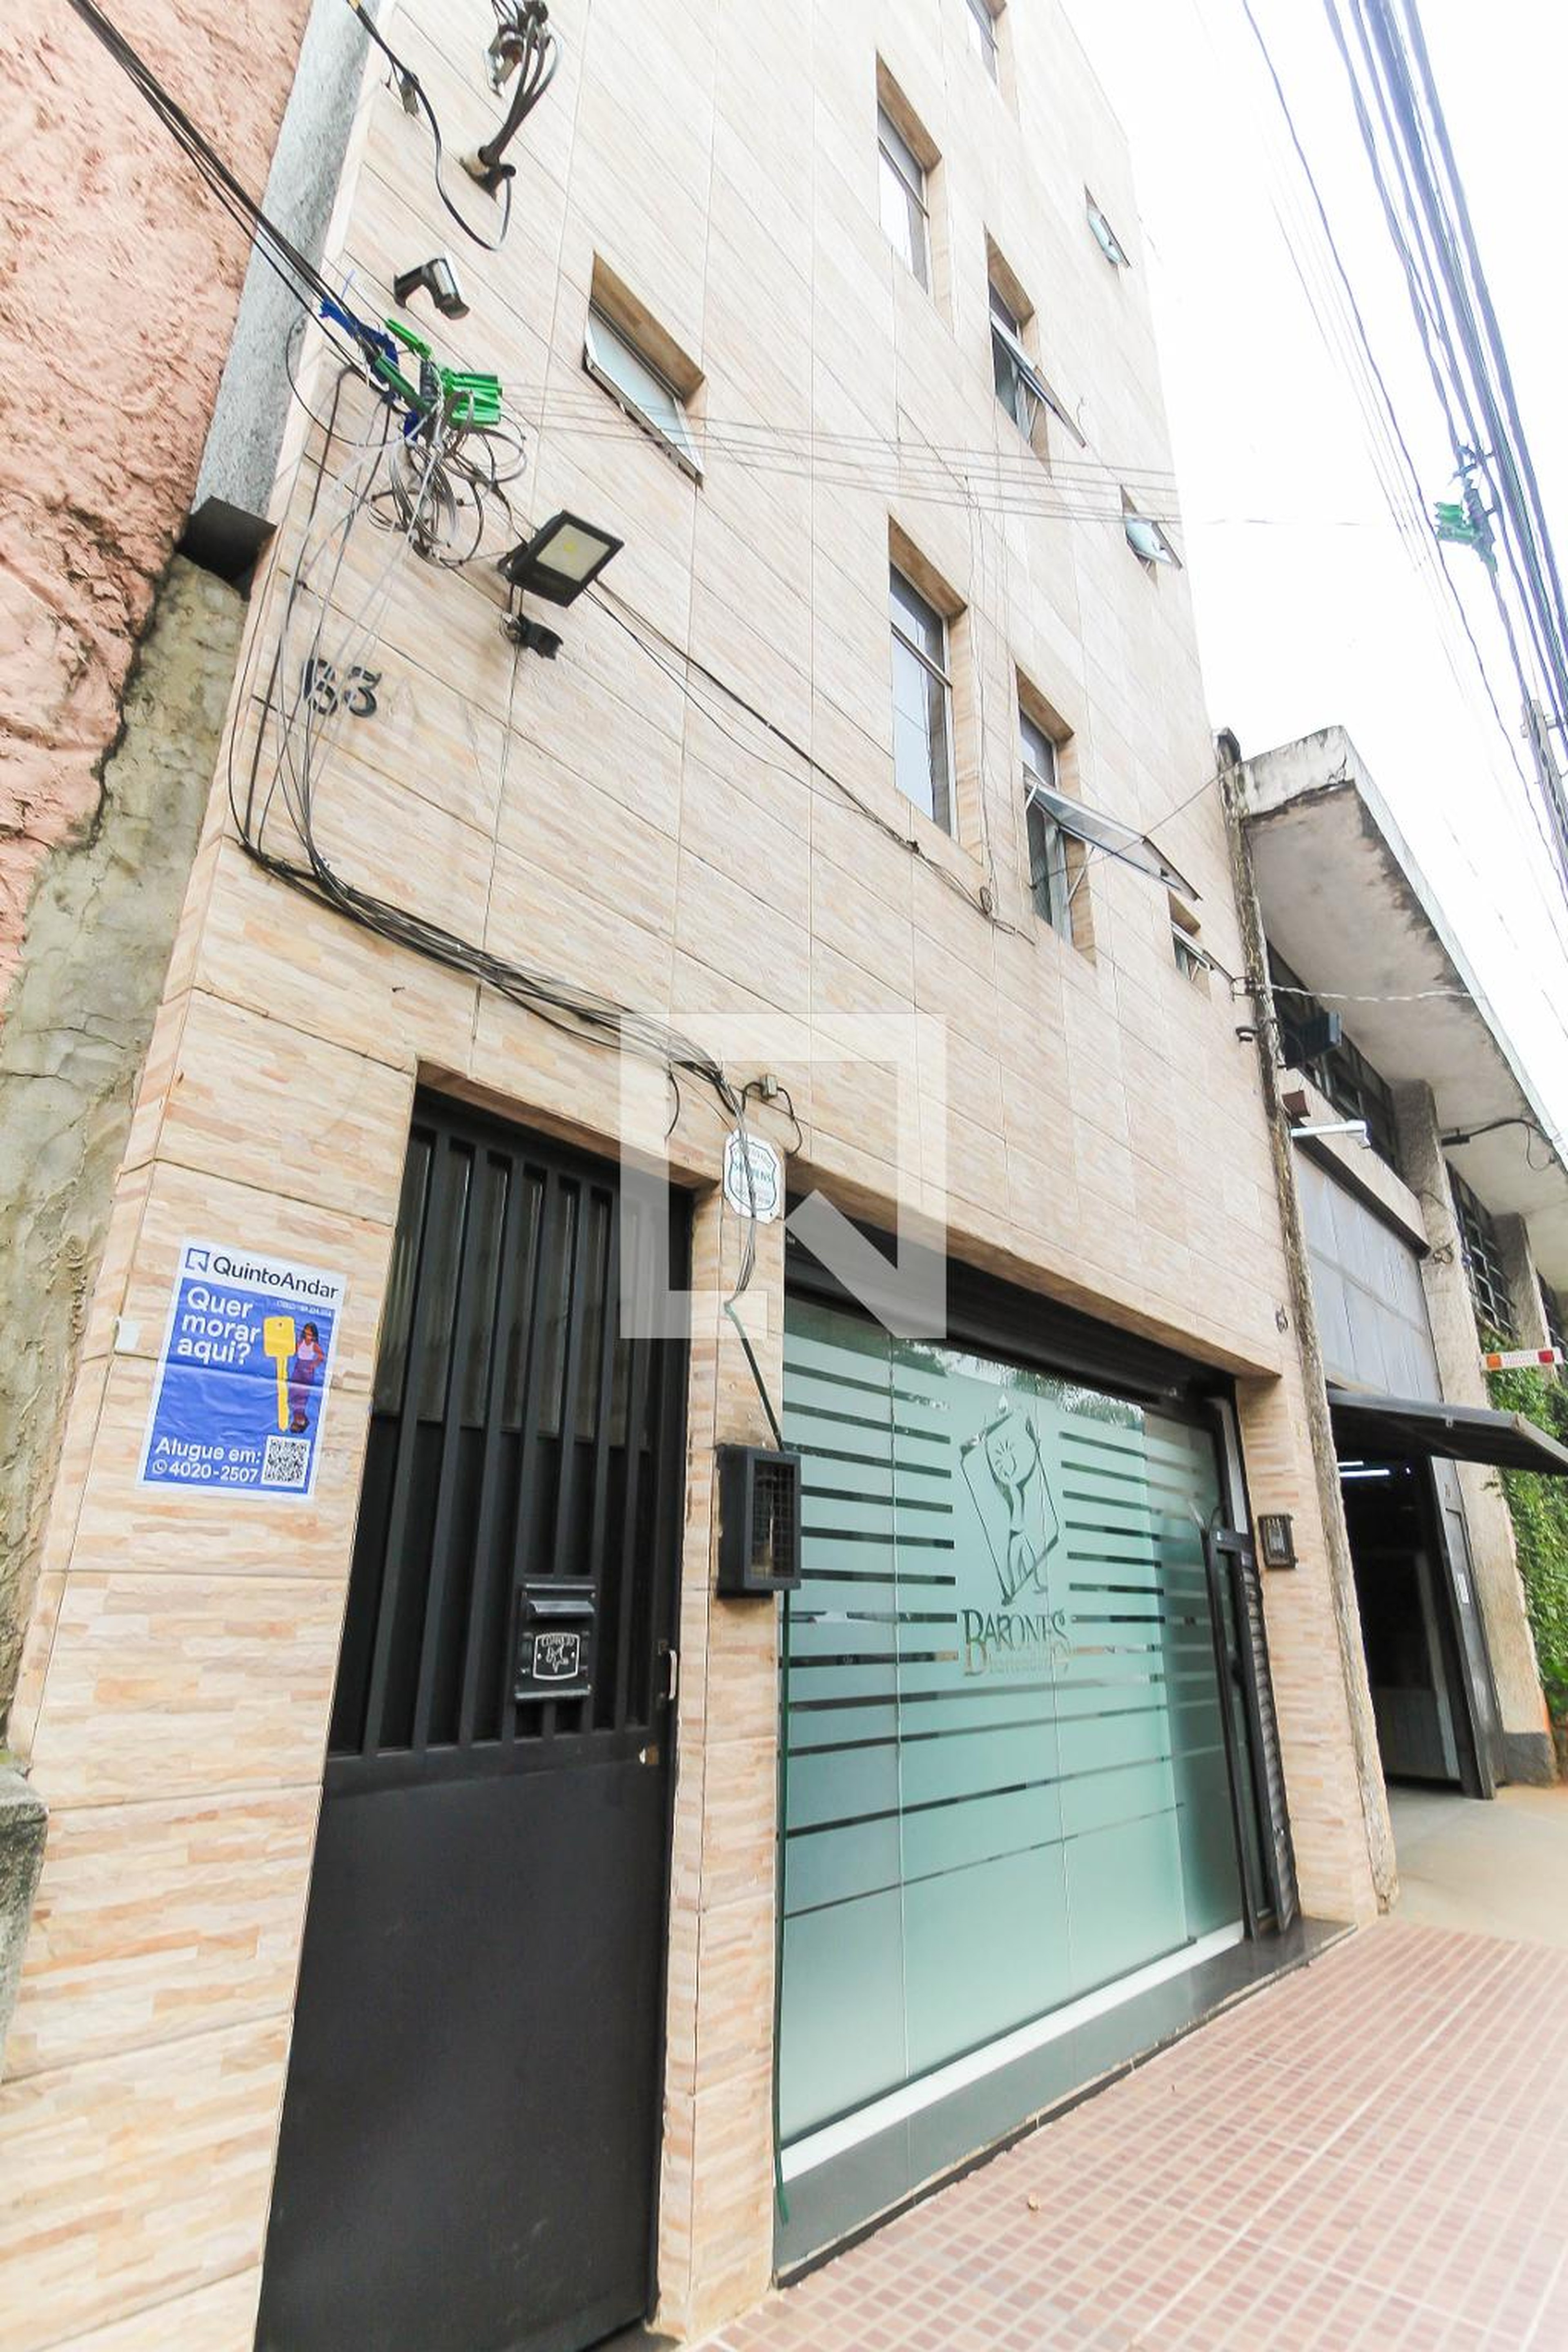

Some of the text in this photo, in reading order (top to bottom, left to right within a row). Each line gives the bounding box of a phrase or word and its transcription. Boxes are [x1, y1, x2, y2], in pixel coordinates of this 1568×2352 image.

[213, 1256, 339, 1299] QuintoAndar
[187, 1286, 254, 1319] Quer
[182, 1312, 261, 1343] morar
[177, 1335, 251, 1365] aqui?
[155, 1437, 263, 1464] Alugue em:
[169, 1461, 258, 1482] 4020-2507
